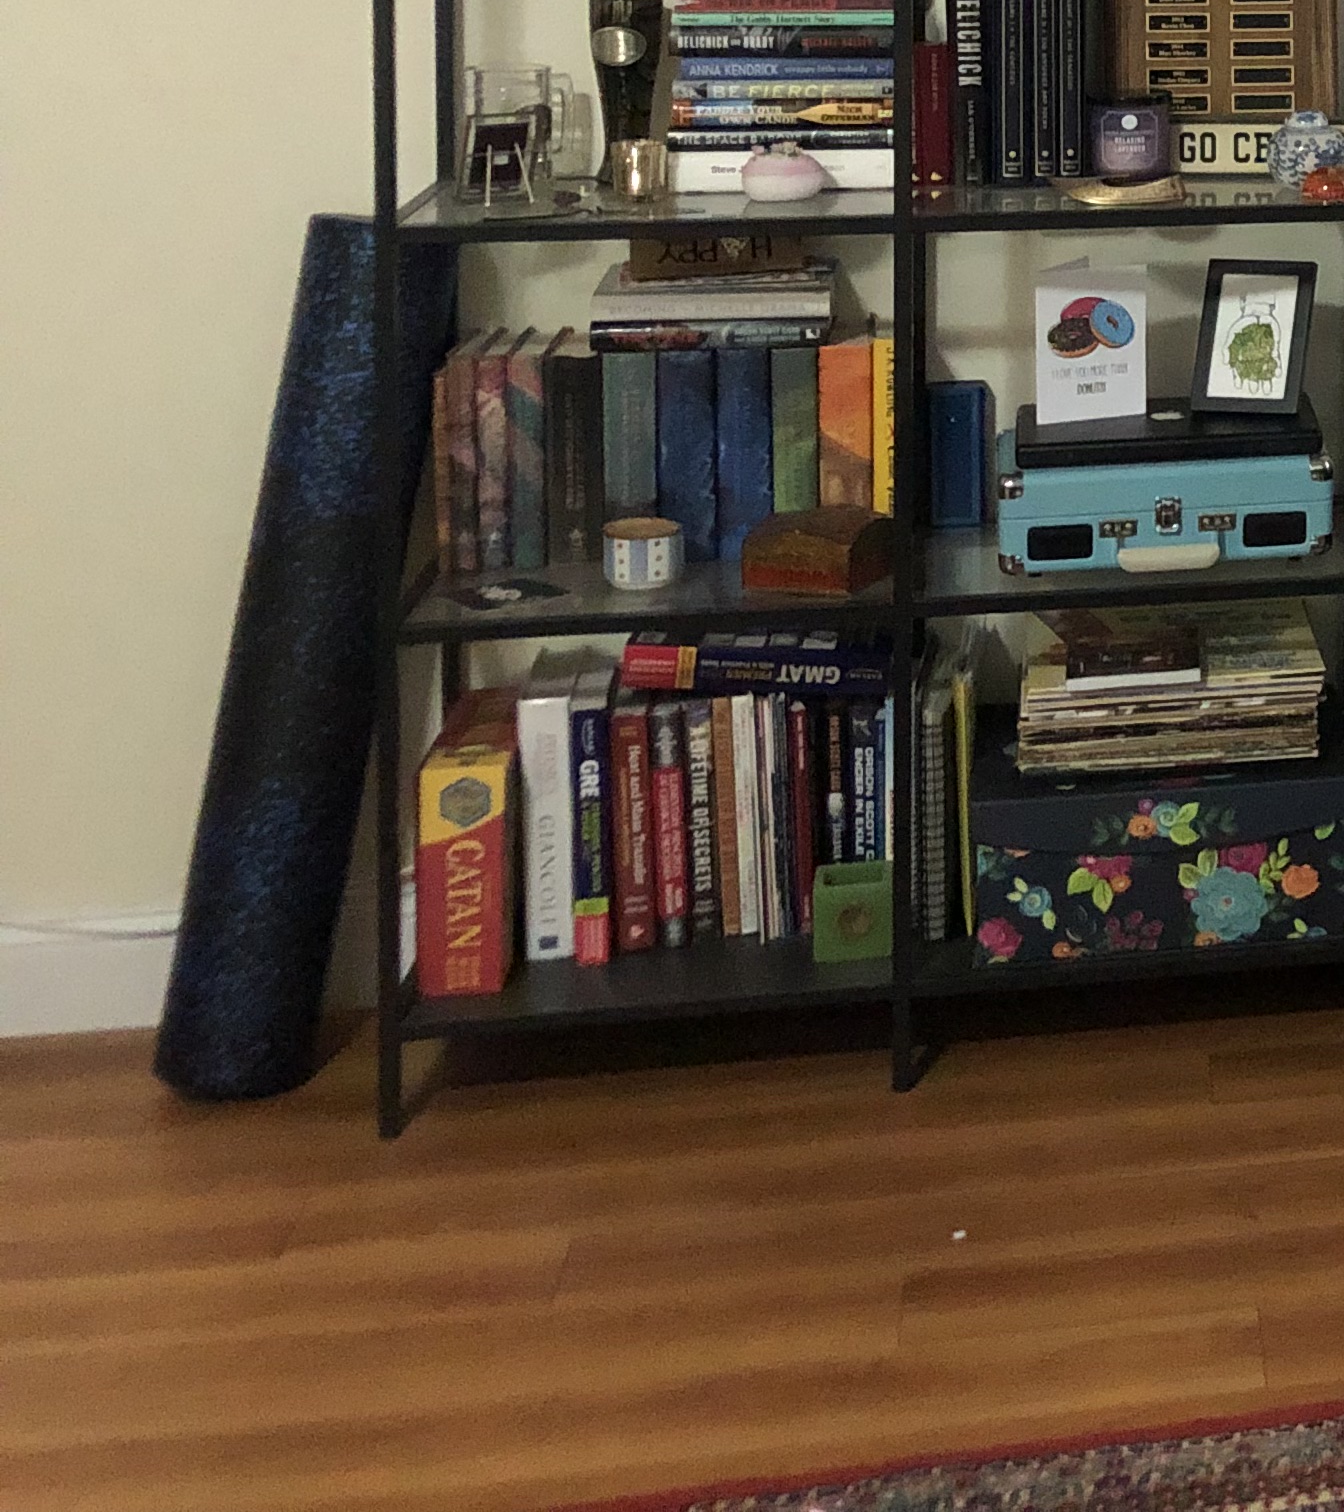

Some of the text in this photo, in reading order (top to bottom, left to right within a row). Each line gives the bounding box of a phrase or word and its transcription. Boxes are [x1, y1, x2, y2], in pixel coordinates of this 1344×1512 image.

[689, 63, 779, 76] ANNA KENDRICK
[713, 84, 835, 99] BE FIERCE
[704, 134, 745, 145] SPACE
[1179, 131, 1218, 164] GO
[711, 165, 737, 174] Steve
[775, 663, 842, 685] GMAT
[628, 744, 643, 775] Heat
[690, 740, 707, 804] LIFETIME
[865, 746, 875, 797] ORSON
[578, 759, 600, 798] GRE
[629, 776, 644, 800] and
[854, 746, 865, 856] ENDER IN EXILE
[864, 800, 875, 847] SCOTT
[694, 829, 712, 892] SECRETS
[445, 839, 485, 950] CATAN
